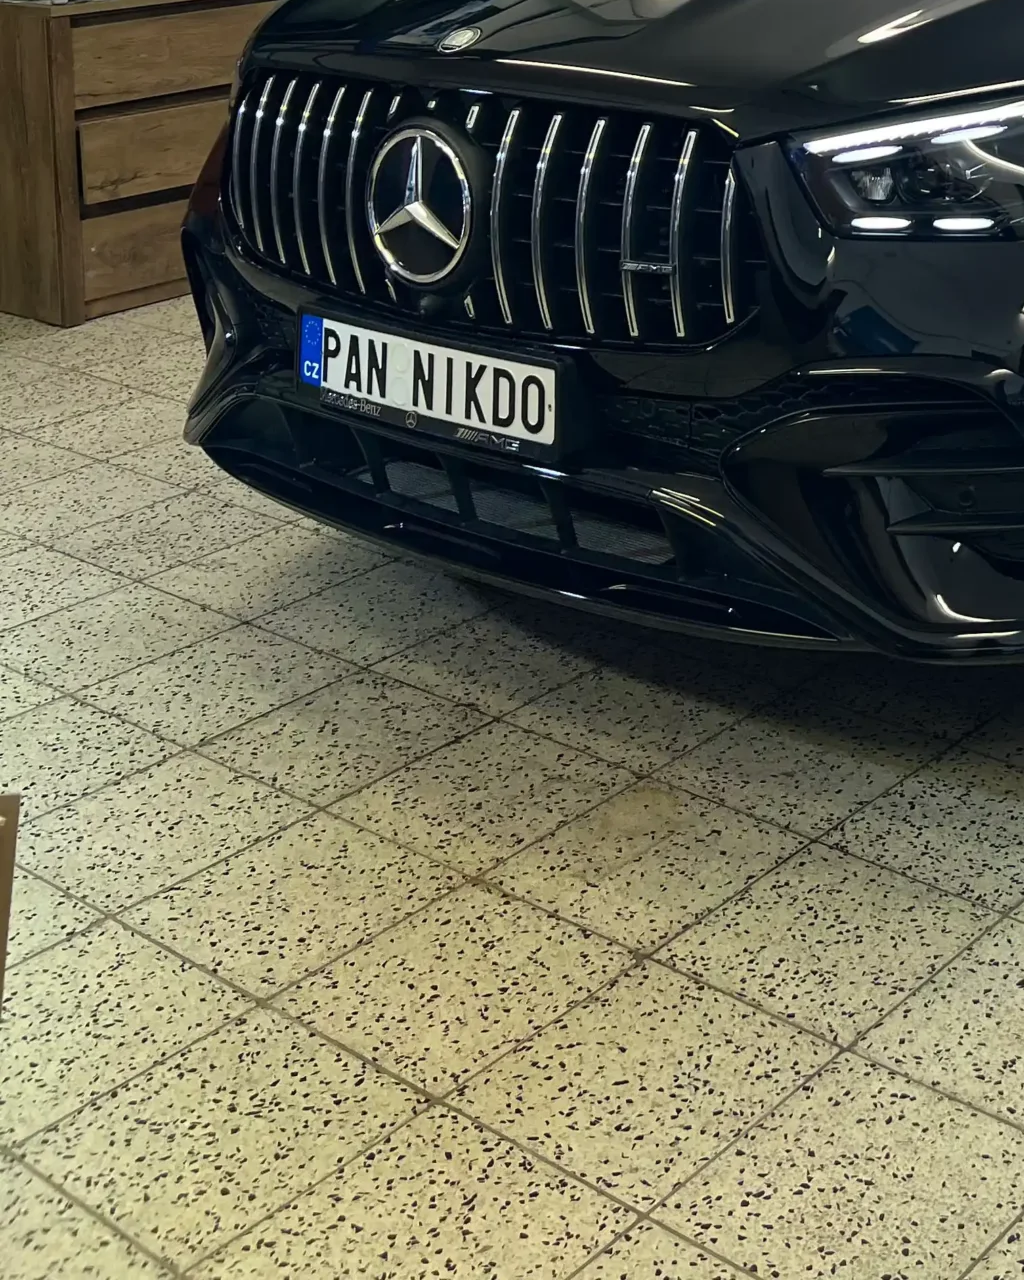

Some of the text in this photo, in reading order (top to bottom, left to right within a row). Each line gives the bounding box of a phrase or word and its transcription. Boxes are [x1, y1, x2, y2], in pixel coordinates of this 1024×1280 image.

[304, 360, 319, 379] CZ
[322, 327, 546, 434] PAN NIKDO
[320, 386, 381, 417] Mercedes-Benz
